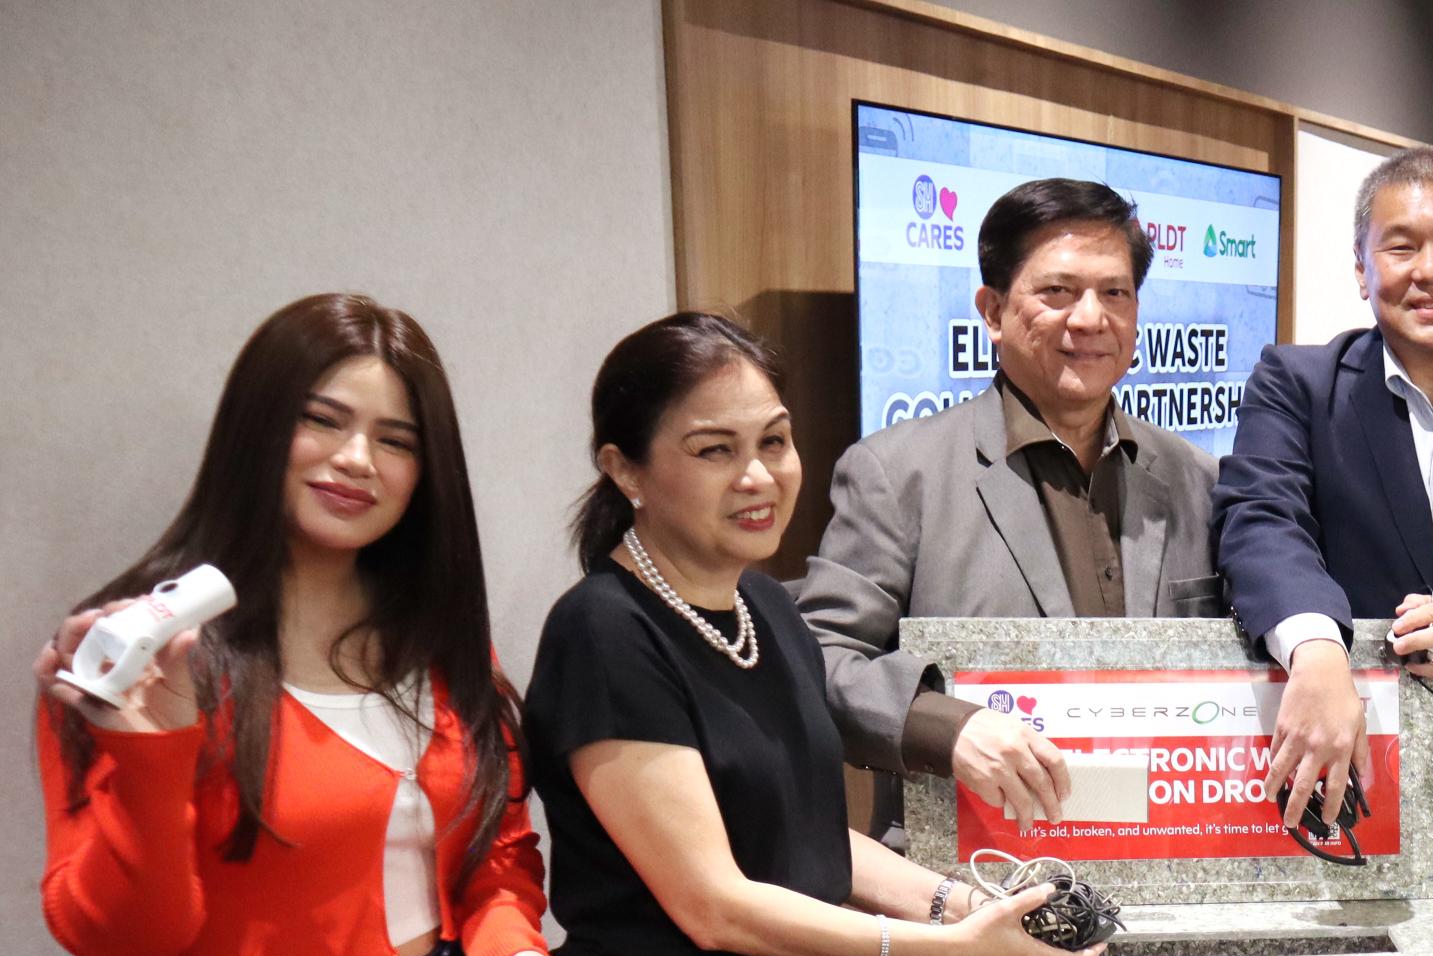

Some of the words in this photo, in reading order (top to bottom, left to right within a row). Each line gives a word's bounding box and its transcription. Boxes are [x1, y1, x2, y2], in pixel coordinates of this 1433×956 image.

[907, 222, 964, 251] CARES
[1220, 231, 1256, 259] Smart
[1147, 328, 1226, 368] WASTE
[1121, 386, 1241, 428] ARTNERSH
[1067, 701, 1257, 725] CYBERZONE
[1203, 780, 1267, 805] DRO
[1049, 826, 1070, 839] old,
[1073, 825, 1115, 838] broken,
[1118, 825, 1140, 836] and
[1143, 823, 1203, 837] unwanted,
[1205, 823, 1221, 835] it's
[1223, 823, 1249, 834] time
[1251, 824, 1262, 834] to
[1265, 823, 1280, 834] let
